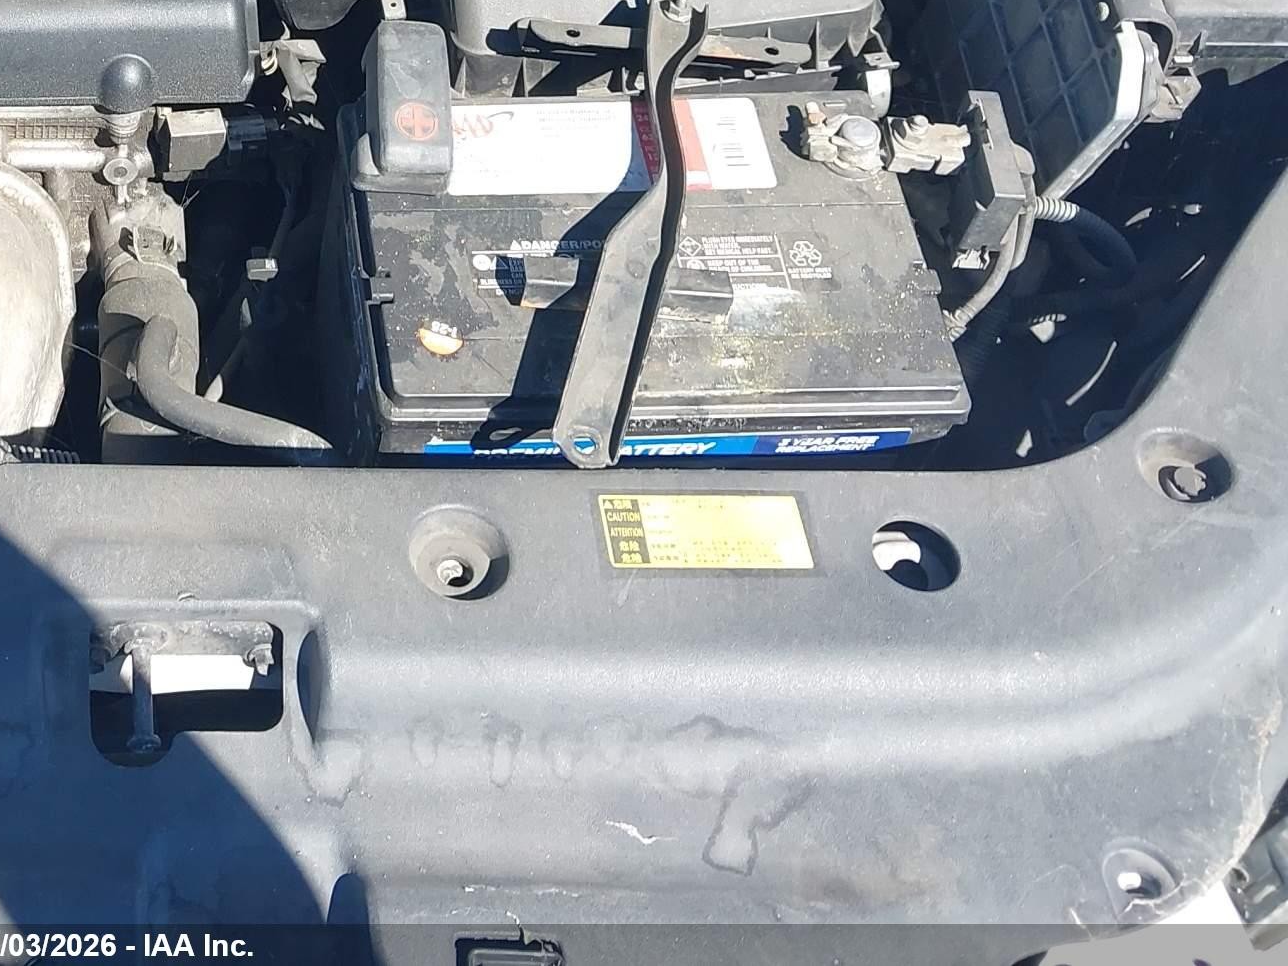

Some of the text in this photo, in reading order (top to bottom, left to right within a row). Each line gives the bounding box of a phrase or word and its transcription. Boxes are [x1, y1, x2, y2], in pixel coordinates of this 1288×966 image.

[618, 442, 717, 457] ATTERY
[606, 511, 641, 522] CAUTION
[610, 527, 644, 537] ATTENTION
